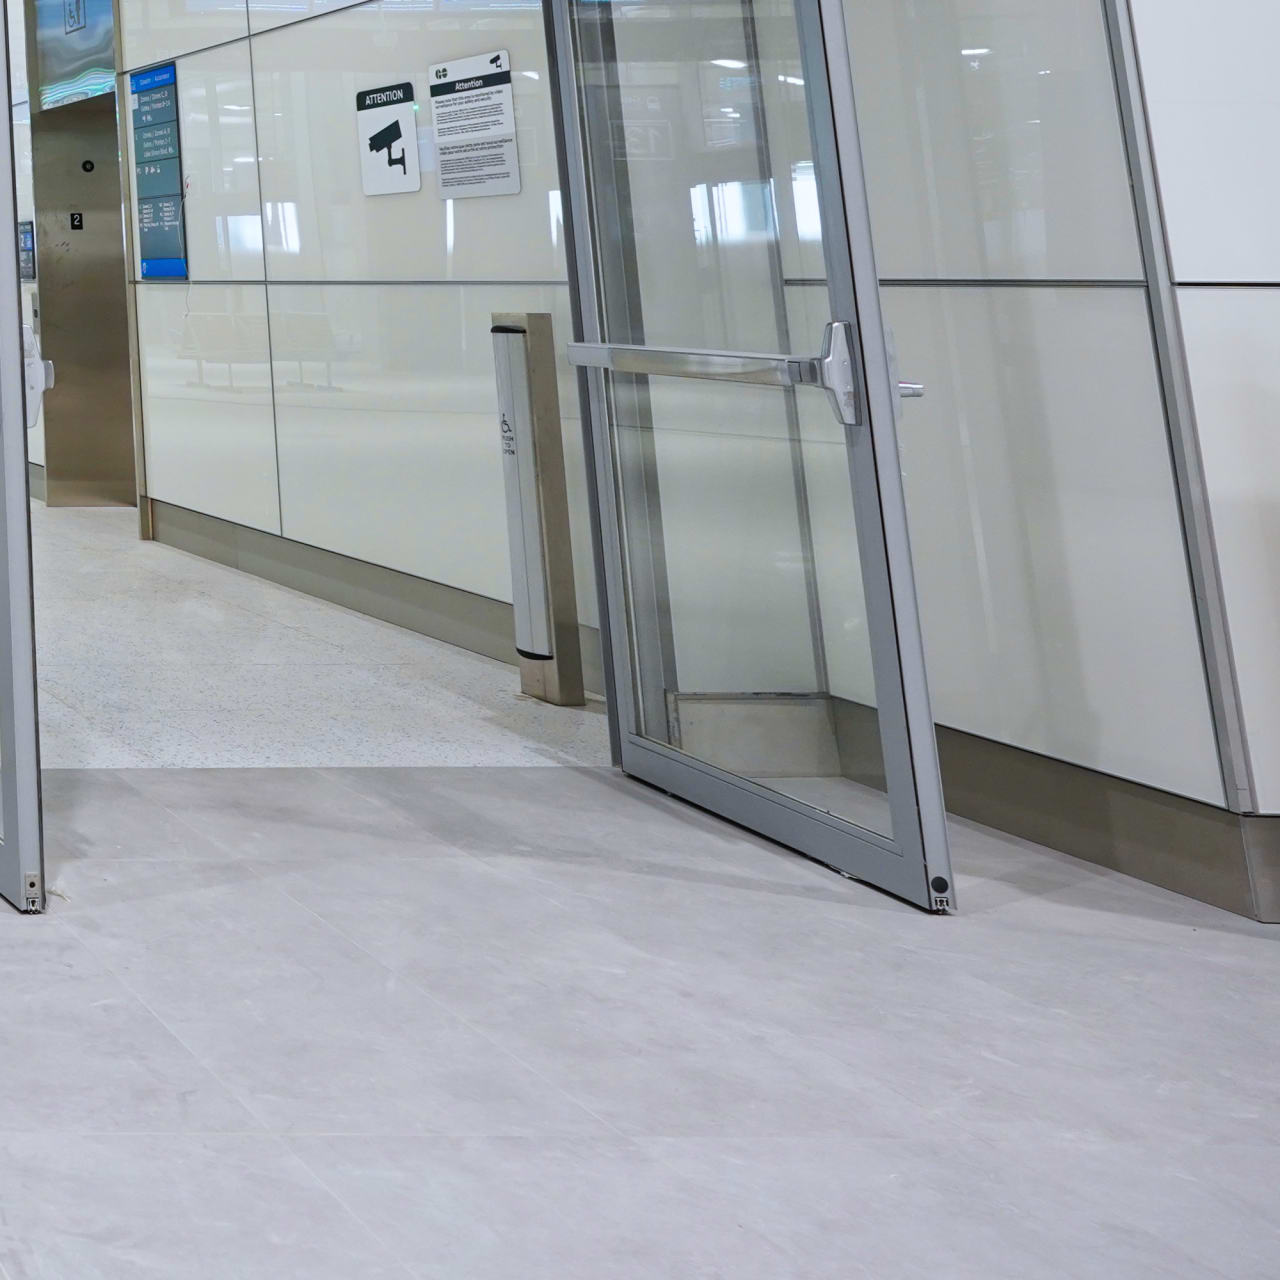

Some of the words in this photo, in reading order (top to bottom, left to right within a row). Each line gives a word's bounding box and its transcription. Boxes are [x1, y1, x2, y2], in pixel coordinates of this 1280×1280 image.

[455, 78, 483, 91] Attention
[365, 89, 404, 106] ATTENTION
[73, 214, 81, 225] 2
